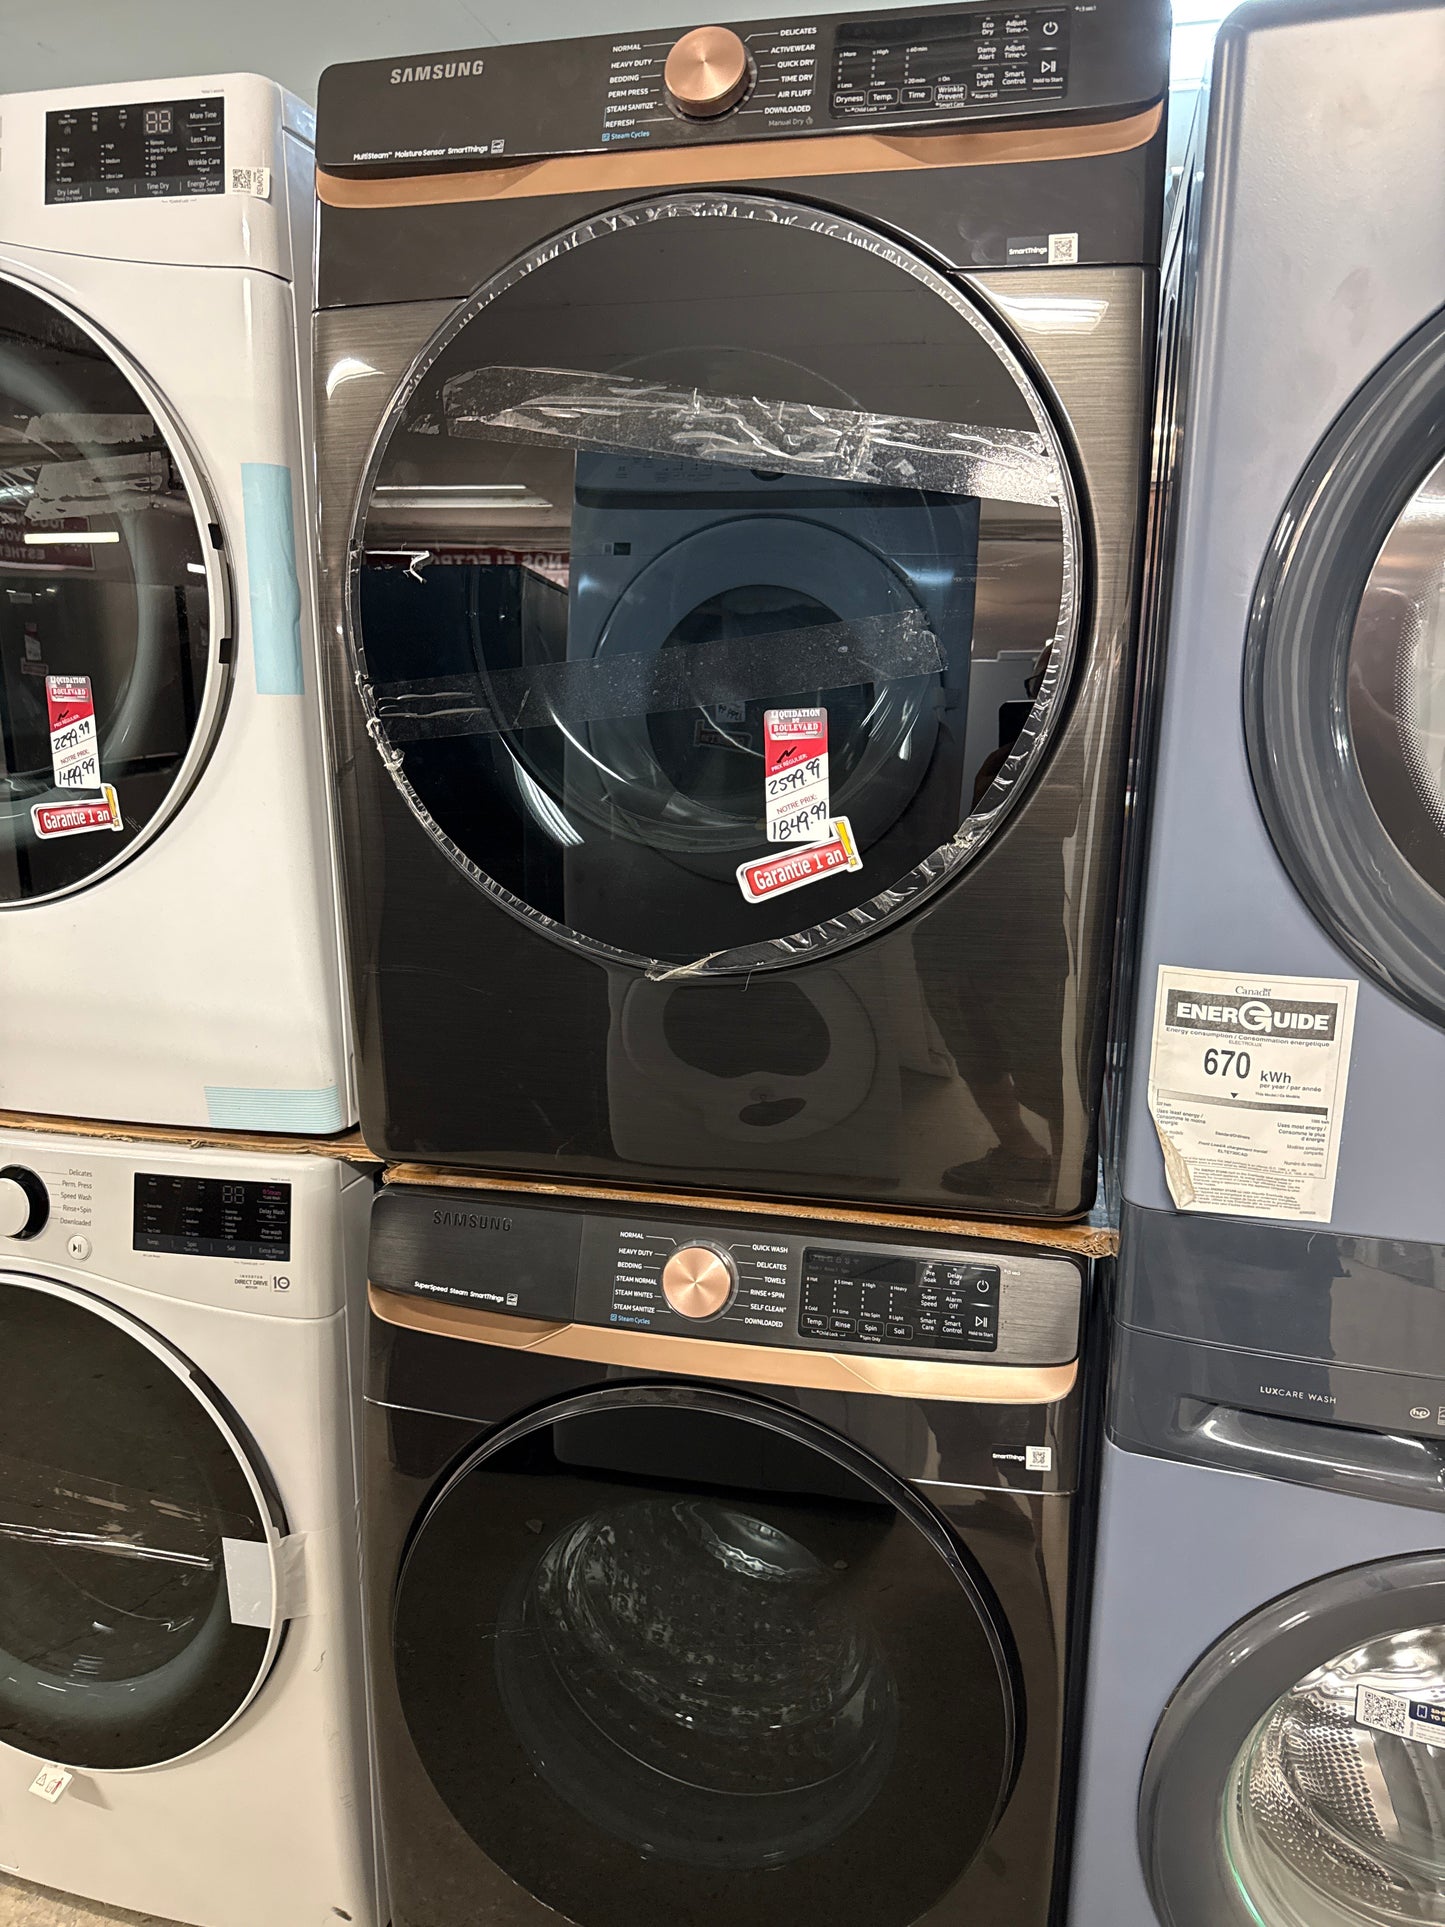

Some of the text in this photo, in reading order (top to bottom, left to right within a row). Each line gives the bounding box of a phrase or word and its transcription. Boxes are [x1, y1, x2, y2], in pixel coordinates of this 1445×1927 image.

[780, 27, 817, 37] DELICATES
[612, 44, 642, 53] NORMAL
[770, 44, 816, 54] ACTIVEWEAR
[1004, 44, 1026, 52] Adjust
[611, 59, 653, 69] HEAVY DUTY
[777, 59, 815, 69] QUICK DRY
[390, 59, 484, 84] SAMSUNG
[609, 74, 640, 84] BEDDING
[1002, 77, 1026, 85] Control
[608, 88, 649, 98] PERM PRESS
[790, 89, 812, 97] FLUFF
[873, 93, 893, 102] Temp.
[908, 91, 926, 99] Time
[836, 95, 864, 103] Dryness
[606, 104, 627, 113] STEAM
[764, 105, 811, 114] DOWNLOADED
[605, 119, 635, 128] REFRESH
[792, 118, 804, 127] Dry
[203, 135, 216, 143] Time
[611, 131, 650, 140] Steam Cycles
[394, 150, 422, 158] Moisture
[422, 148, 446, 157] Sensor
[447, 145, 488, 155] SmartThings
[187, 157, 220, 166] Wrinkle Care
[159, 182, 169, 190] Dry
[187, 180, 205, 188] Energy
[1008, 246, 1048, 256] SmartThings
[50, 676, 86, 685] LIQUIDATION
[771, 709, 820, 720] LIQUIDATION
[773, 723, 819, 731] BOULEVARD
[53, 720, 90, 750] 2299.99
[60, 754, 73, 765] NOTRE
[58, 758, 95, 786] 1499.99
[771, 764, 782, 772] PRIX
[768, 758, 820, 795] 2599.99
[776, 800, 800, 815] NOTRE
[43, 808, 110, 829] Garantie 1 an
[772, 801, 827, 840] 1849.99
[754, 848, 844, 891] Garantie 1 an
[1235, 985, 1272, 997] Canada
[1176, 1000, 1330, 1033] ENERGUIDE
[1166, 1026, 1188, 1035] Energy
[1190, 1029, 1233, 1039] consumption
[1238, 1034, 1289, 1045] Consommation
[1203, 1048, 1251, 1079] 670
[1260, 1070, 1292, 1083] kWh
[69, 1169, 93, 1177] Delicates
[78, 1181, 93, 1189] Press
[60, 1192, 76, 1200] Speed
[62, 1204, 92, 1214] Rinse+Spin
[60, 1217, 91, 1227] Downloaded
[433, 1208, 513, 1232] SAMSUNG
[620, 1231, 644, 1239] NORMAL
[752, 1244, 788, 1254] QUICK WASH
[617, 1261, 642, 1269] BEDDING
[756, 1261, 787, 1270] DELICATES
[635, 1276, 657, 1285] NORMAL
[764, 1276, 786, 1285] TOWELS
[947, 1272, 962, 1280] Delay
[414, 1281, 504, 1303] SuperSpeed Steam SmartThings
[750, 1289, 785, 1299] RINSE SPIN
[921, 1293, 937, 1301] Super
[921, 1300, 937, 1308] Speed
[632, 1305, 655, 1313] SANITIZE
[634, 1317, 650, 1325] Cycles
[744, 1317, 783, 1328] DOWNLOADED
[807, 1317, 823, 1326] Temp.
[864, 1324, 877, 1332] Spin
[893, 1327, 905, 1335] Soil
[942, 1326, 962, 1334] Control
[1260, 1386, 1337, 1404] LUXCARE WASH
[992, 1453, 1025, 1461] SmartThings
